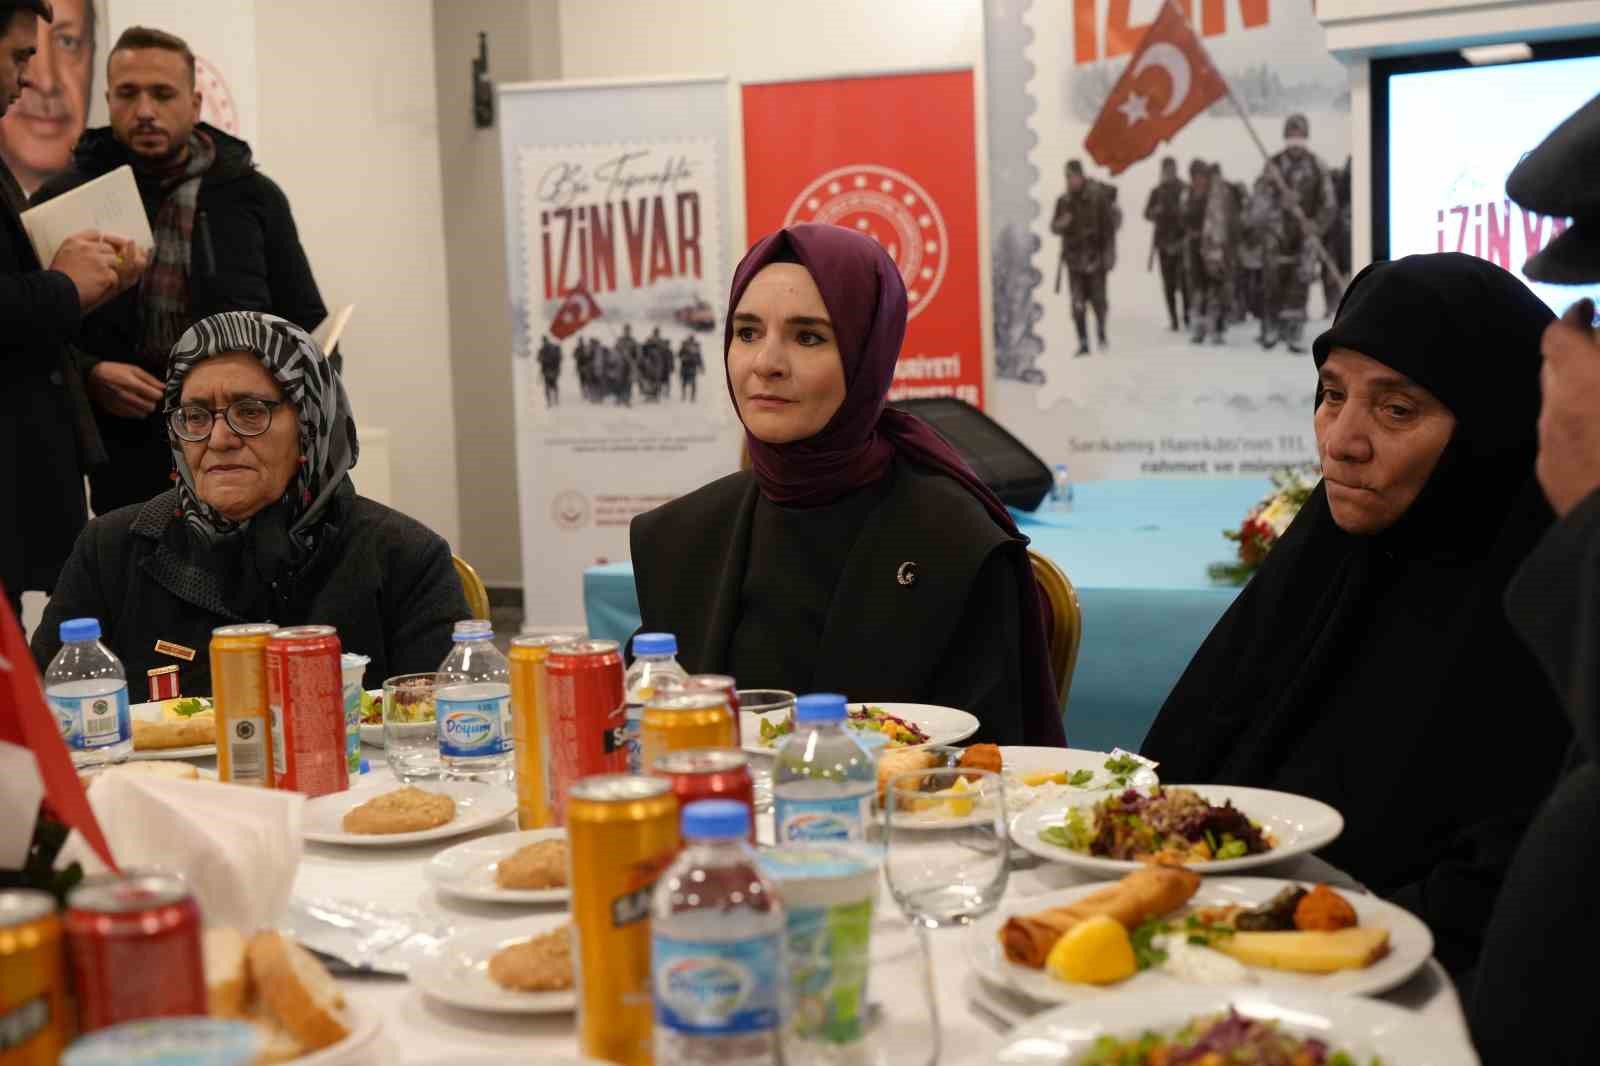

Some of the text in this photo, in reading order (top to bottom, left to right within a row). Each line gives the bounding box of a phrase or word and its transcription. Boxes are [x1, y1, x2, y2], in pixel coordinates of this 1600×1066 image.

[620, 191, 703, 288] VAR
[1141, 459, 1207, 473] rahmet
[1214, 462, 1234, 473] ve
[446, 718, 491, 738] Doyum
